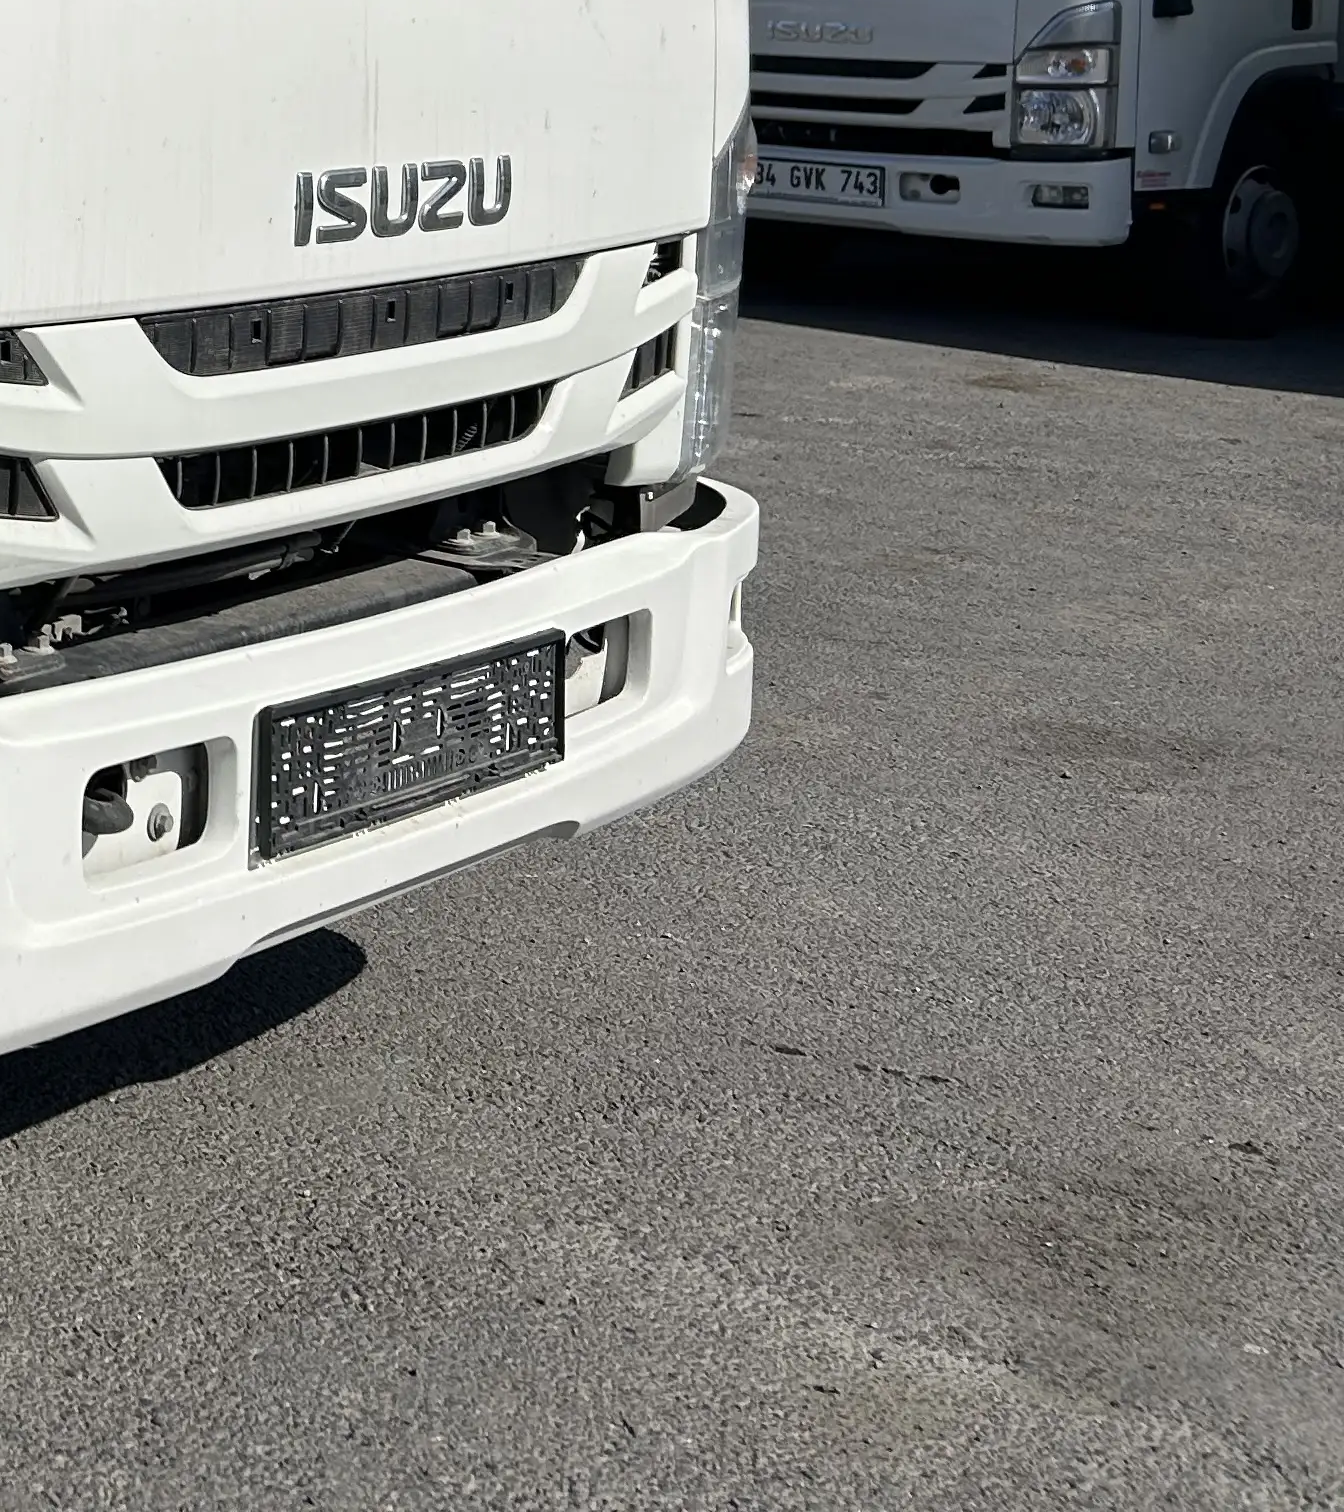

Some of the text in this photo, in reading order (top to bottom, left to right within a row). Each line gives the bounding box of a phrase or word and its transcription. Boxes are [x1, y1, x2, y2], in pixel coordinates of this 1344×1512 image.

[767, 20, 873, 45] ISUZU
[755, 162, 878, 195] 34 GVK 743
[294, 154, 511, 247] ISUZU
